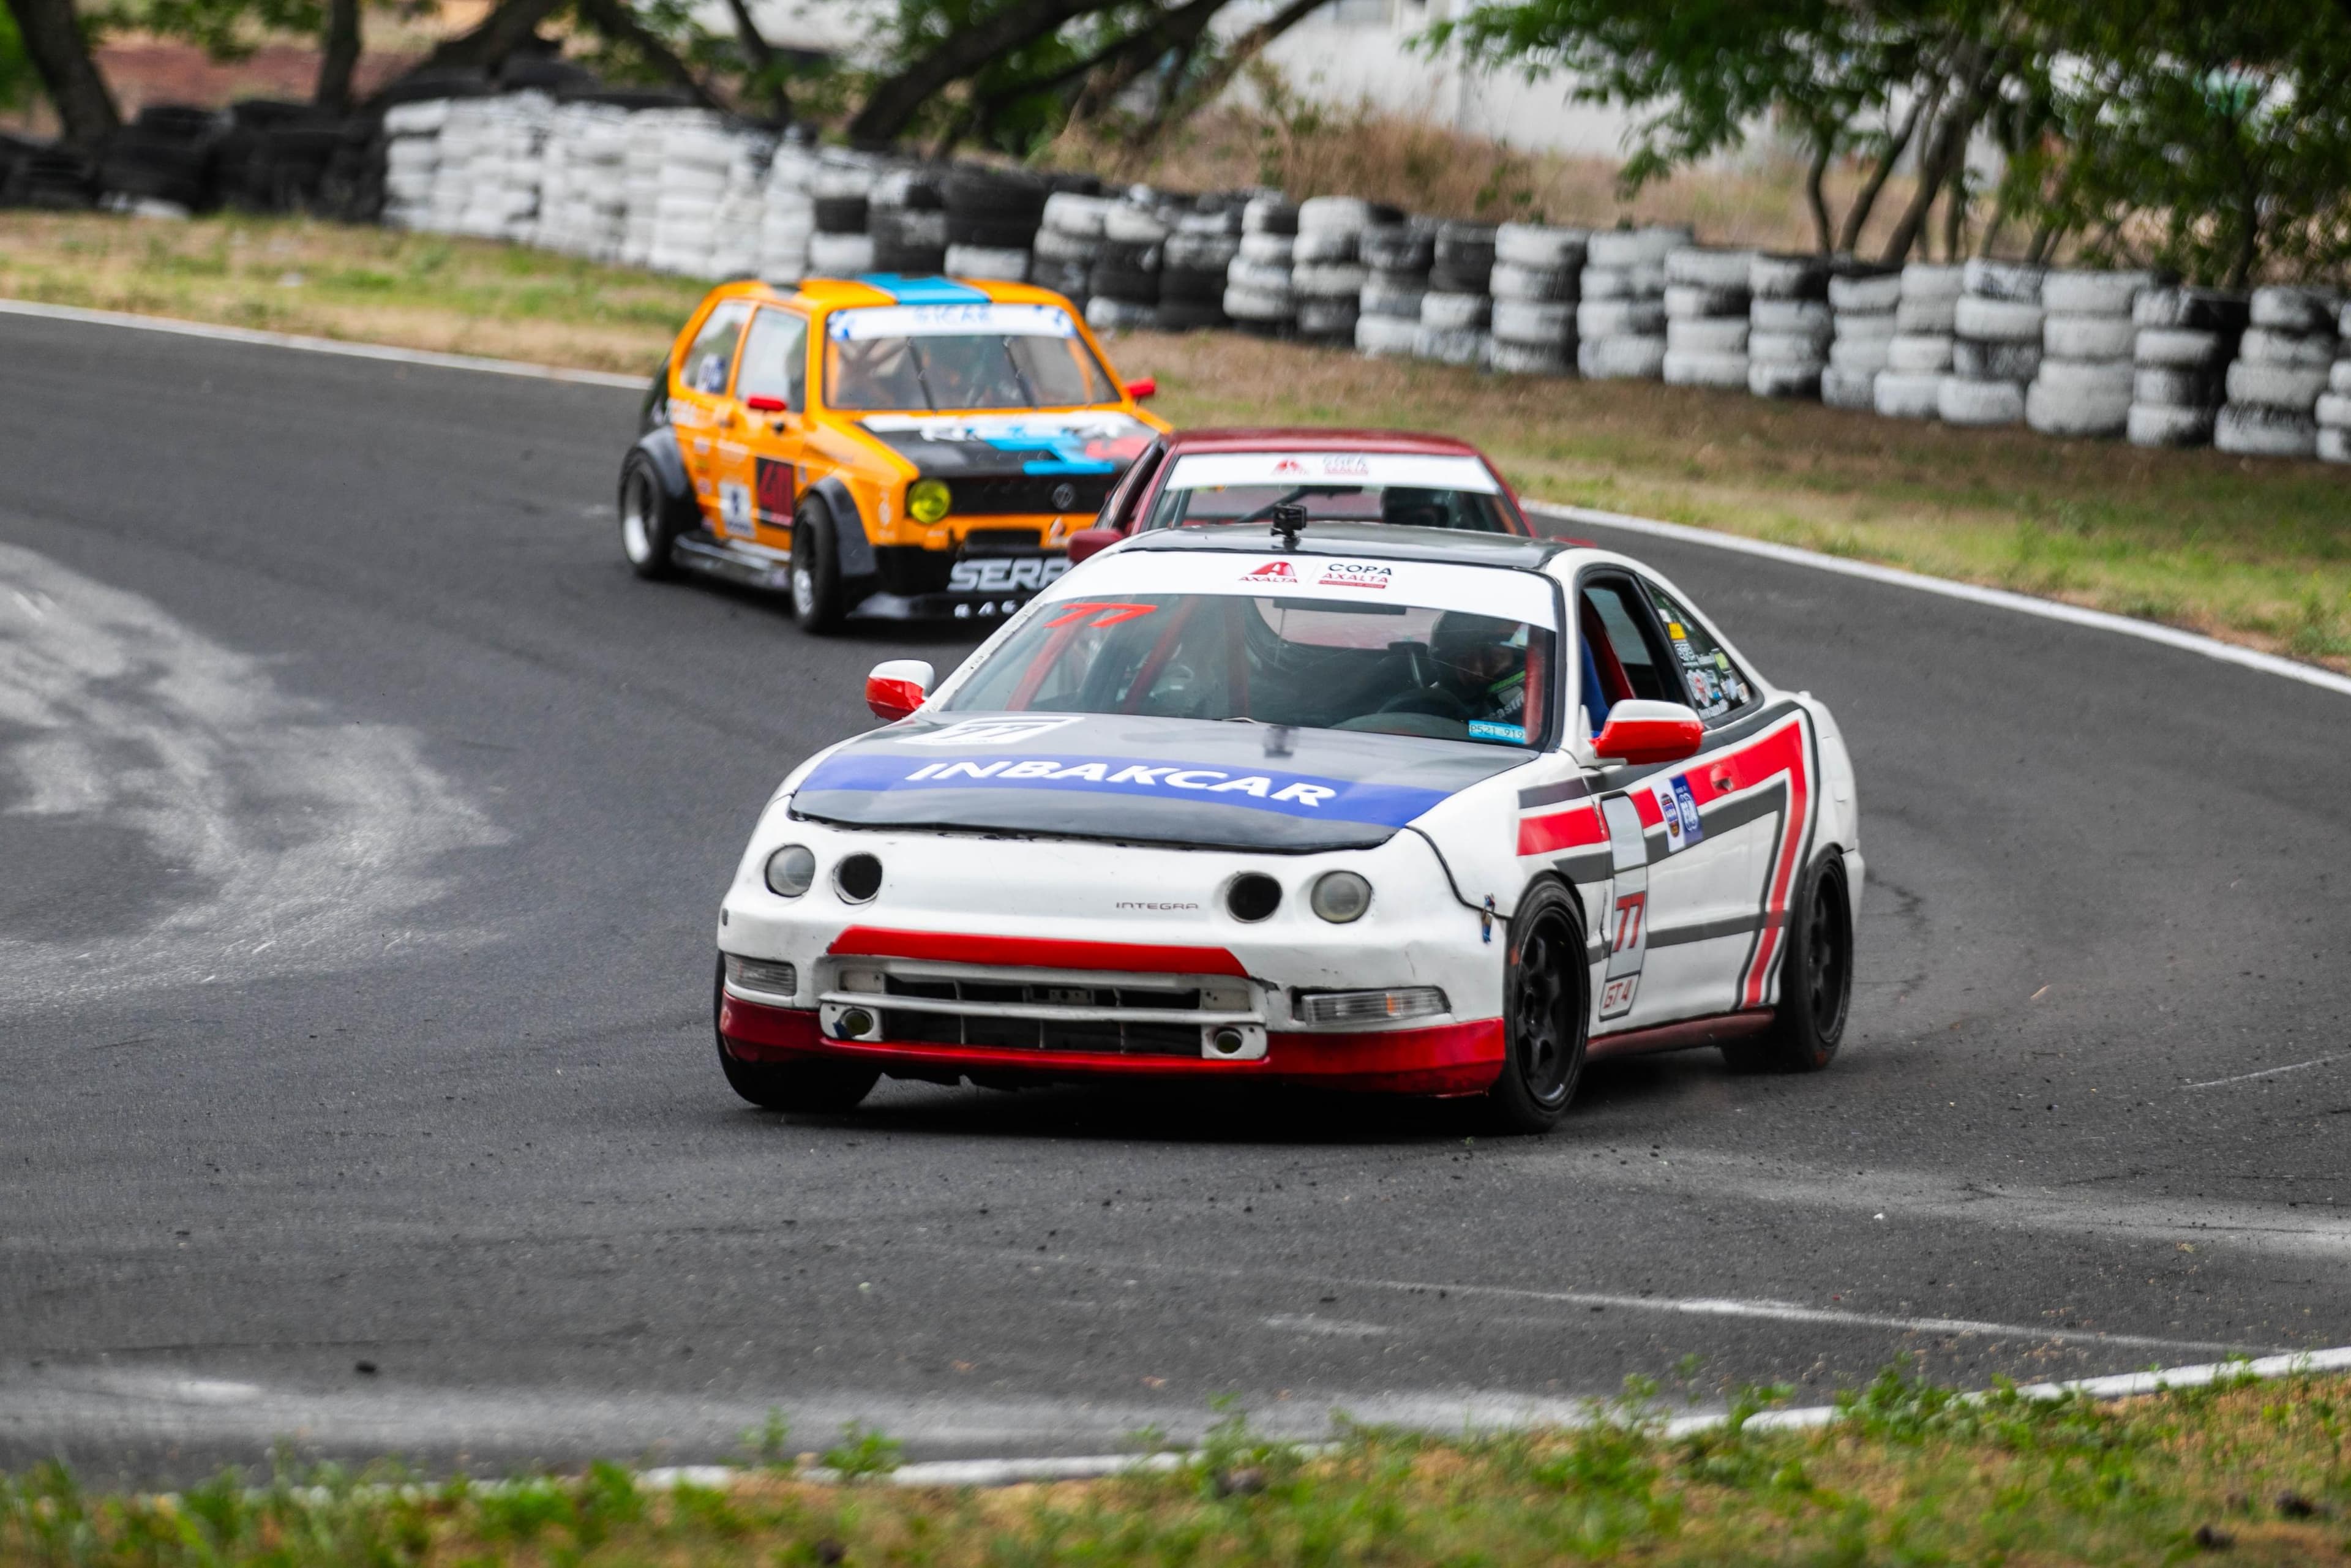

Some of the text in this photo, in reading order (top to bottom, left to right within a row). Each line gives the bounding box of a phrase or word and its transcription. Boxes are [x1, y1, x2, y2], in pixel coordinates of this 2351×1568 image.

[1322, 572, 1389, 583] AXALTA
[1329, 563, 1392, 576] COPA
[1043, 602, 1159, 628] 77
[1471, 724, 1496, 736] P521
[1504, 729, 1524, 740] 919
[905, 760, 1337, 807] INBAKCAR
[1611, 890, 1646, 953] 77
